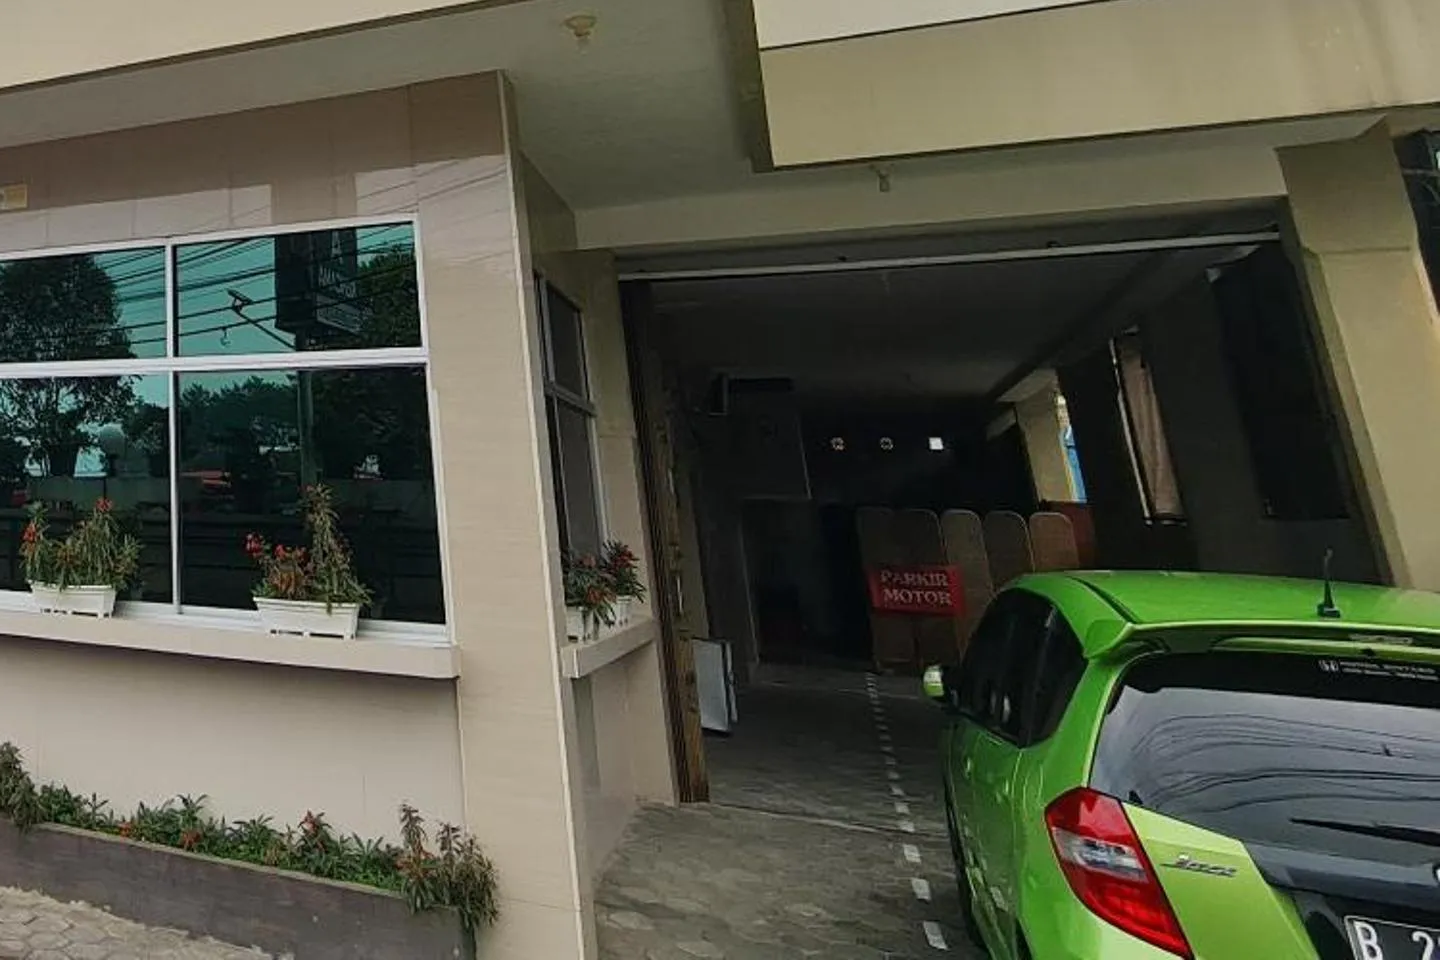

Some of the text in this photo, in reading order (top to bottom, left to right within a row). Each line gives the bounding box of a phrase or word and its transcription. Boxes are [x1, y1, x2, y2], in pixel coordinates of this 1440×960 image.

[880, 568, 950, 588] PARKIR
[883, 586, 954, 608] MOTOR
[1352, 920, 1440, 960] B 2
